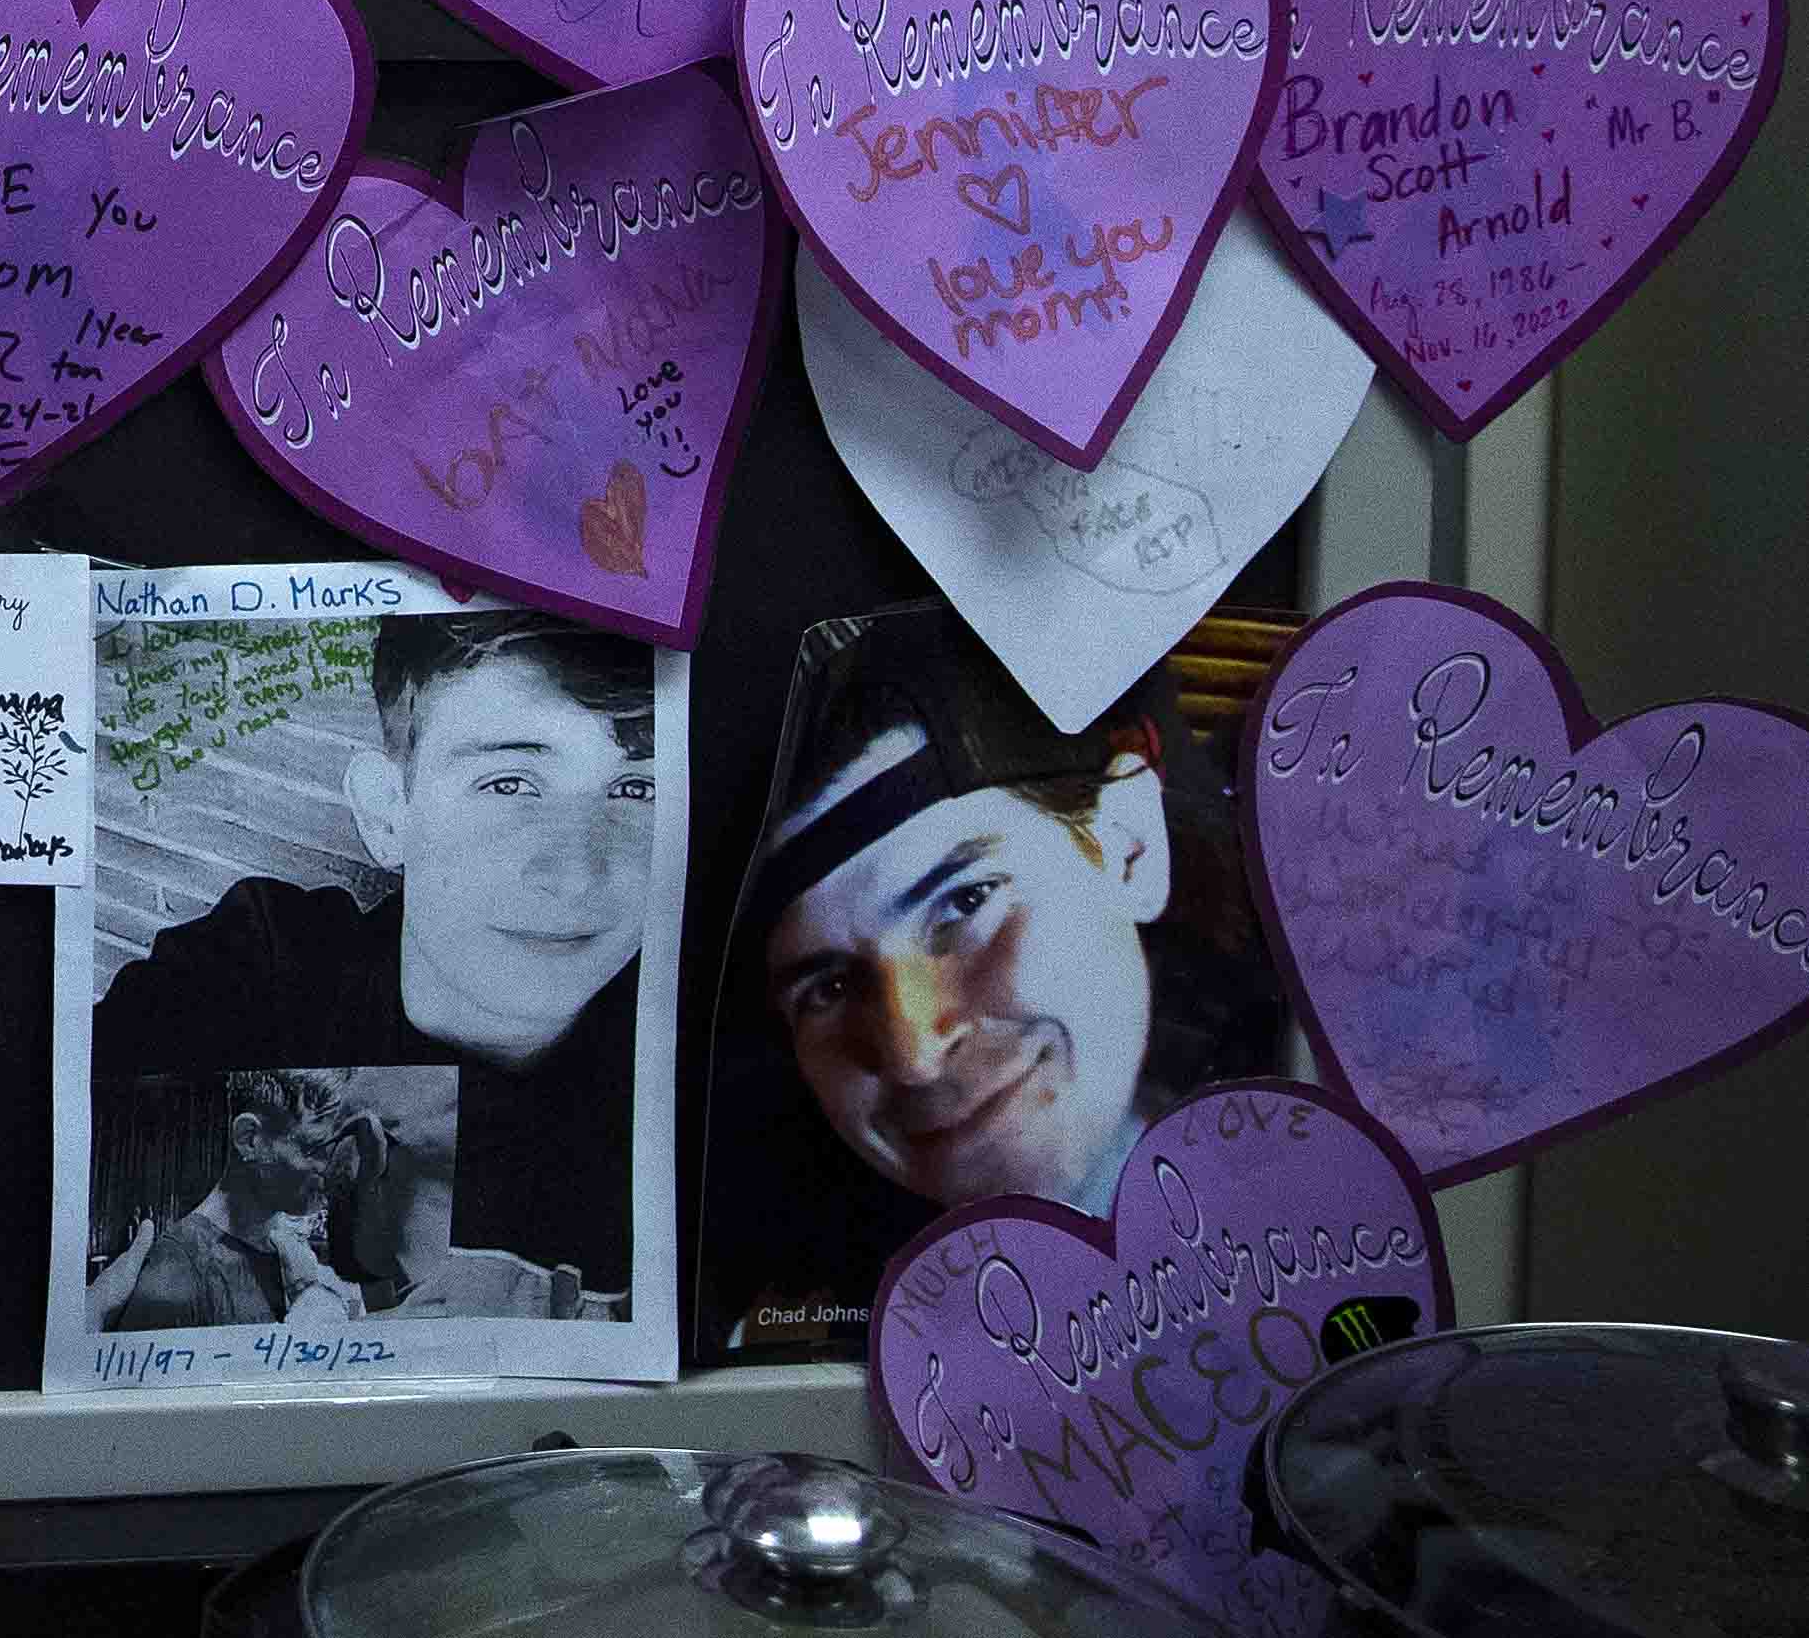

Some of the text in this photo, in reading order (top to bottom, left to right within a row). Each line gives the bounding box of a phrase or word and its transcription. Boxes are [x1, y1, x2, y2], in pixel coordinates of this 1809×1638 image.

[1281, 73, 1517, 161] Brandon
[1364, 142, 1490, 204] Scott
[1437, 165, 1573, 261] Arnold
[251, 313, 352, 450] In
[95, 583, 210, 616] Nathan
[758, 1307, 807, 1329] Chad
